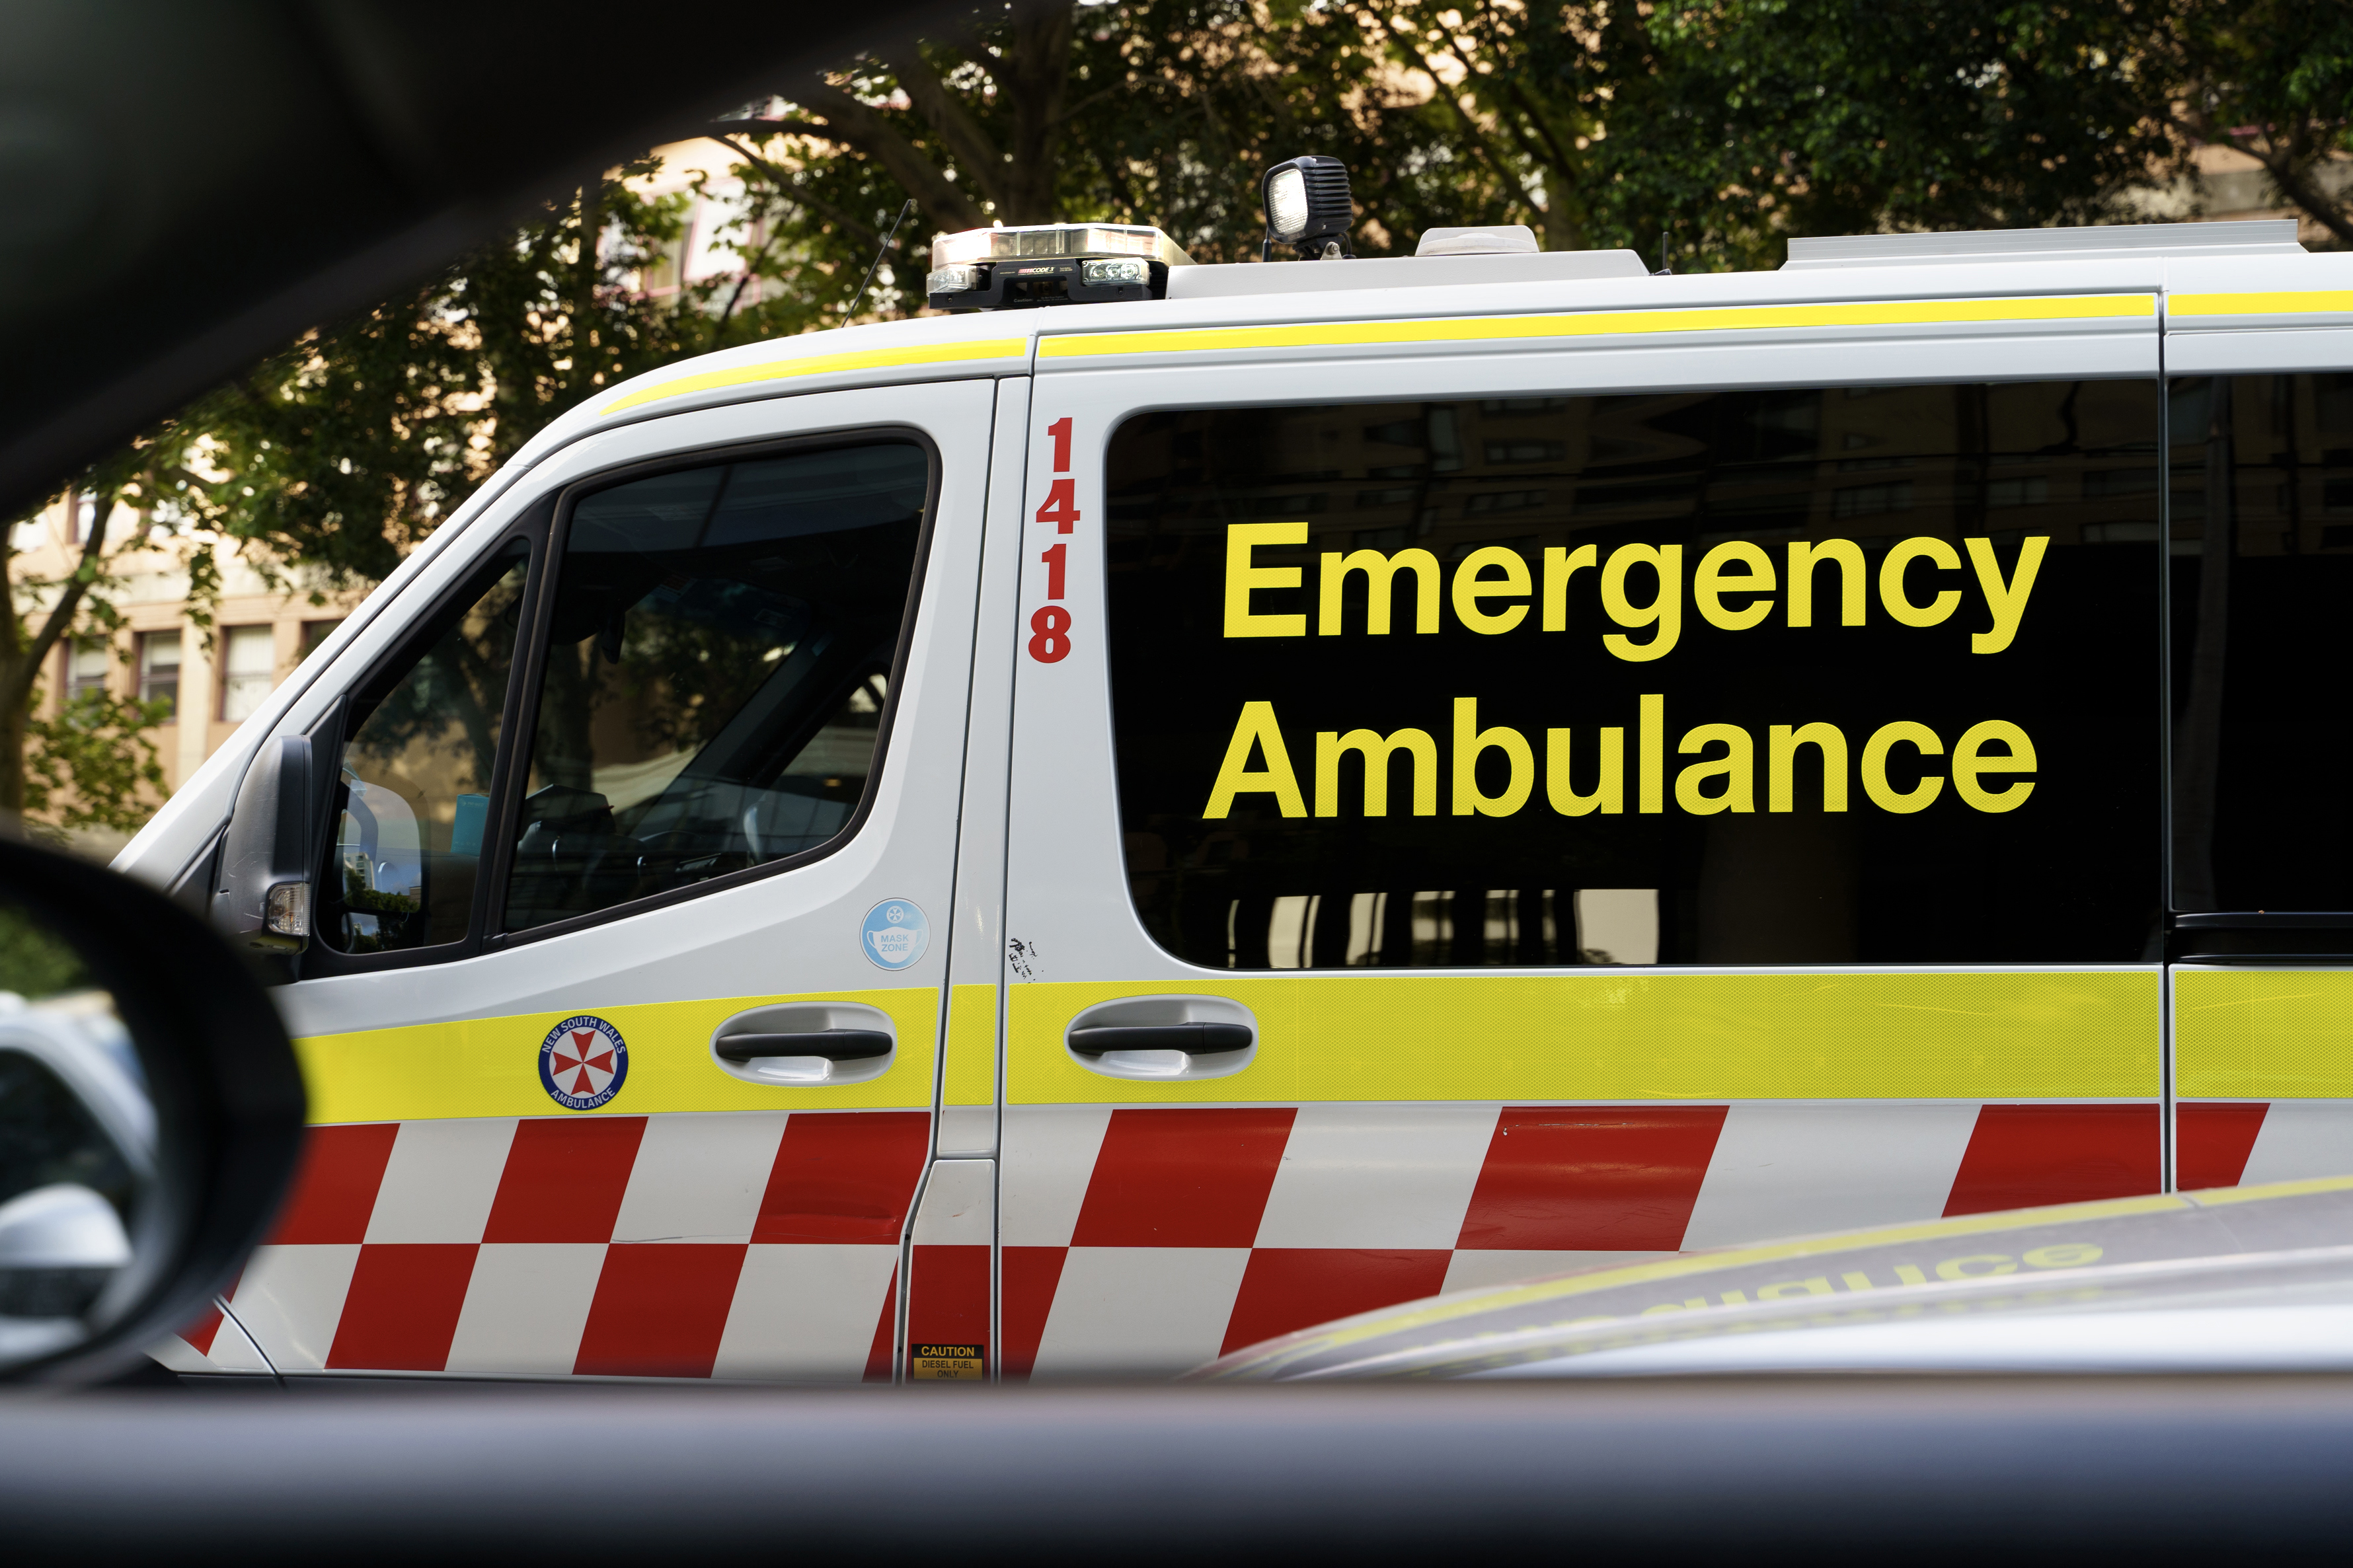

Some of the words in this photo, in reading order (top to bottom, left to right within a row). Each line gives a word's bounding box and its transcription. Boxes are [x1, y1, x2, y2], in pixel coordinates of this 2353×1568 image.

[1223, 521, 2050, 662] Emergency
[1202, 693, 2037, 819] Ambulance
[881, 943, 908, 952] ZONE
[542, 1027, 560, 1053] NEW
[560, 1017, 598, 1031] SOUTH
[599, 1021, 626, 1054] WALES
[551, 1087, 615, 1109] AMBULANCE
[921, 1346, 975, 1357] CAUTION
[922, 1360, 950, 1368] DIESEL
